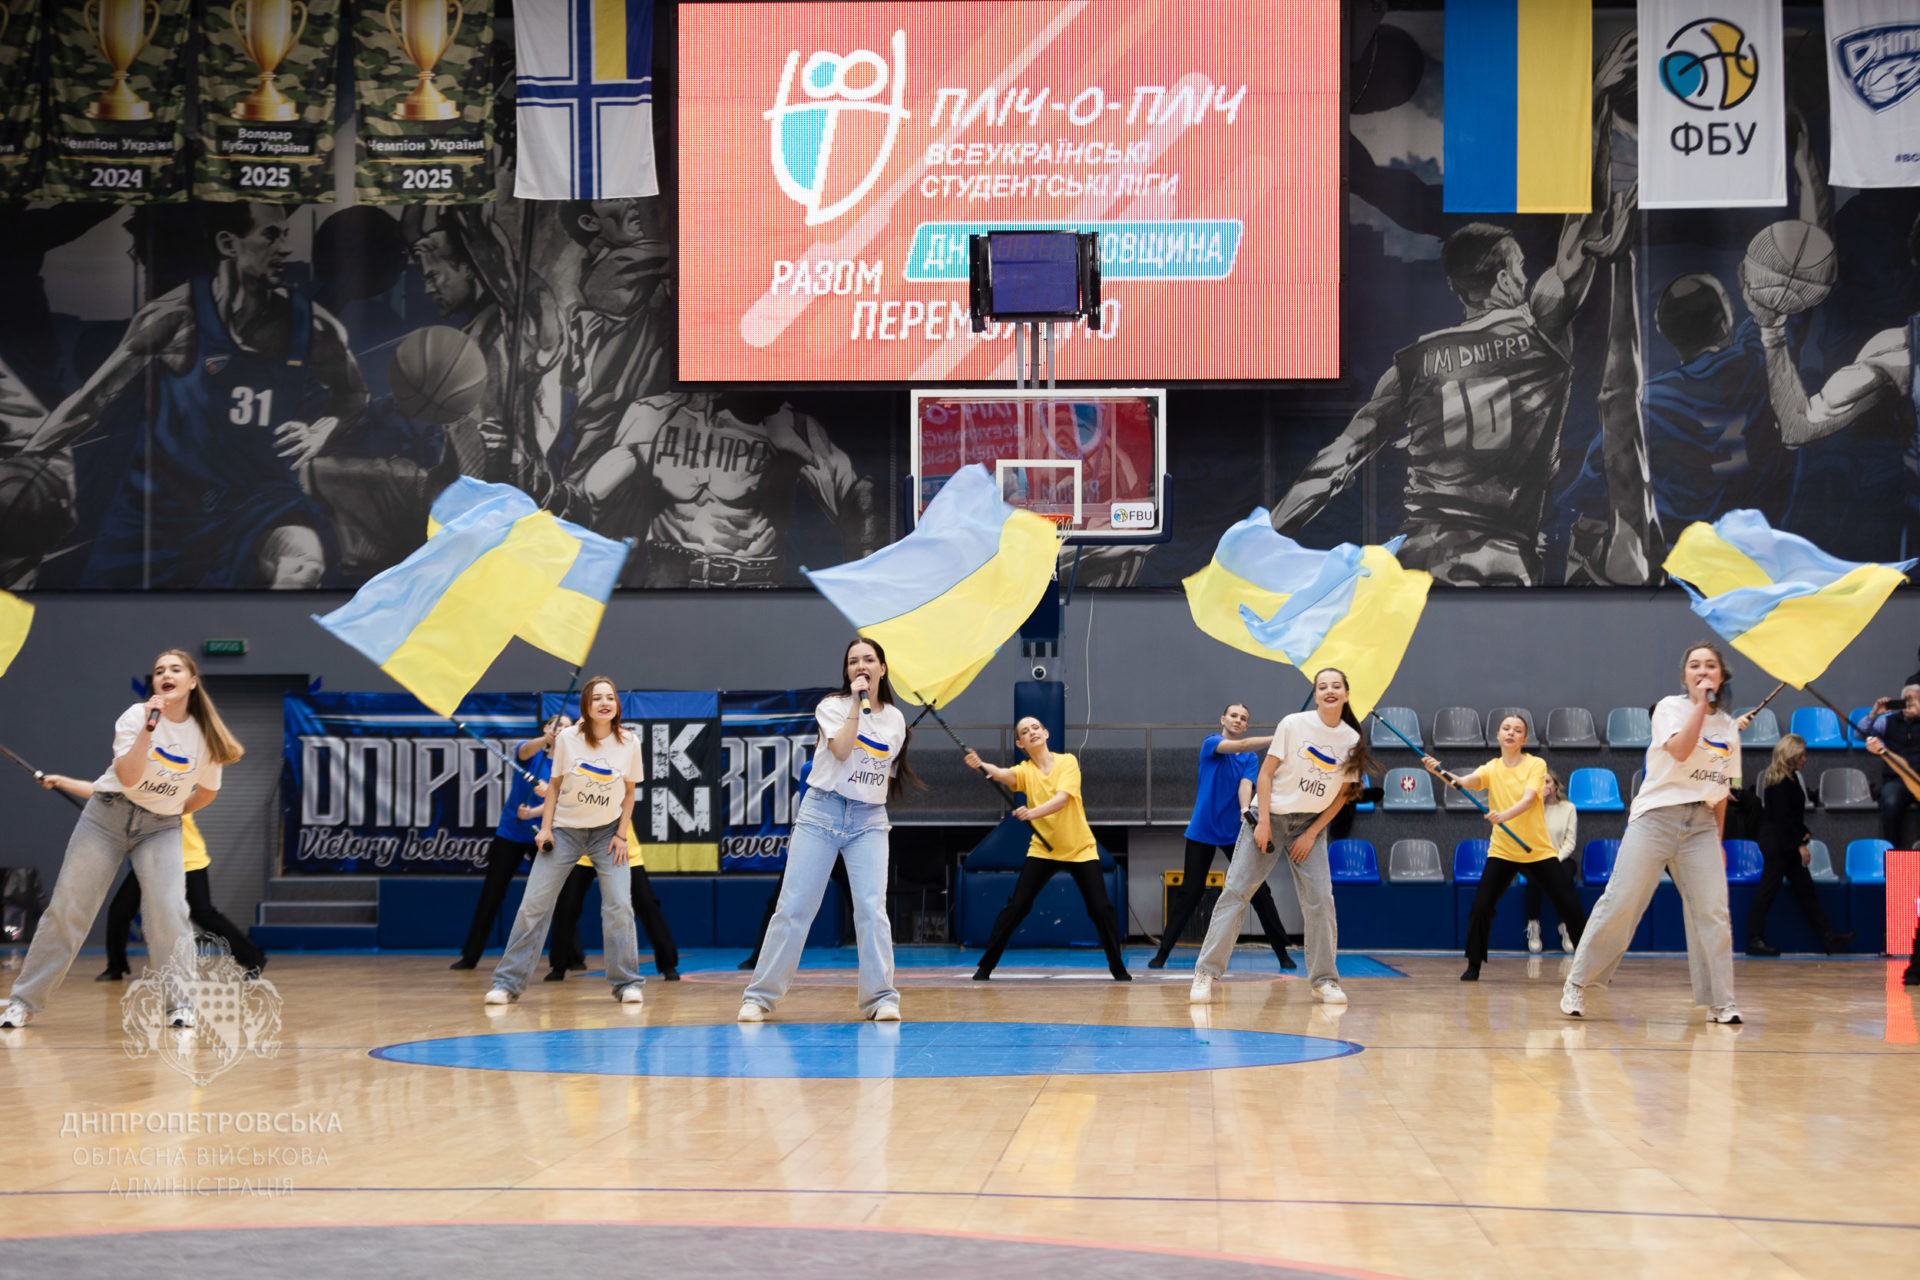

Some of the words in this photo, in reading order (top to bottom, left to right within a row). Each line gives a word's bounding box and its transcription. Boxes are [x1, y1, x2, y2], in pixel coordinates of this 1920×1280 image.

[930, 84, 1248, 127] ПЛІЧ-О-ПЛІЧ
[61, 137, 118, 150] Чемпіон
[238, 128, 293, 141] Володар
[1670, 121, 1757, 157] ФБУ
[222, 140, 258, 153] Кубку
[260, 141, 310, 154] України
[367, 139, 426, 152] Чемпіон
[429, 138, 485, 153] України
[925, 138, 1152, 166] ВСЕУКРАЇНСЬКІ
[90, 168, 143, 188] 2024
[240, 165, 290, 188] 2025
[402, 169, 453, 189] 2025
[920, 174, 1109, 202] СТУДЕНТСЬКІ
[1114, 173, 1179, 197] ЛІГИ
[771, 260, 883, 295] РАЗОМ
[1458, 334, 1530, 368] DNIPRO
[229, 386, 273, 427] 31
[656, 425, 769, 475] ДНІПРО
[1129, 510, 1153, 521] FBU
[138, 780, 179, 797] ЛЬВІВ
[847, 770, 885, 787] ДНІПРО
[1298, 777, 1326, 797] КИЇВ
[577, 791, 610, 808] СУМИ
[297, 827, 400, 868] Victory
